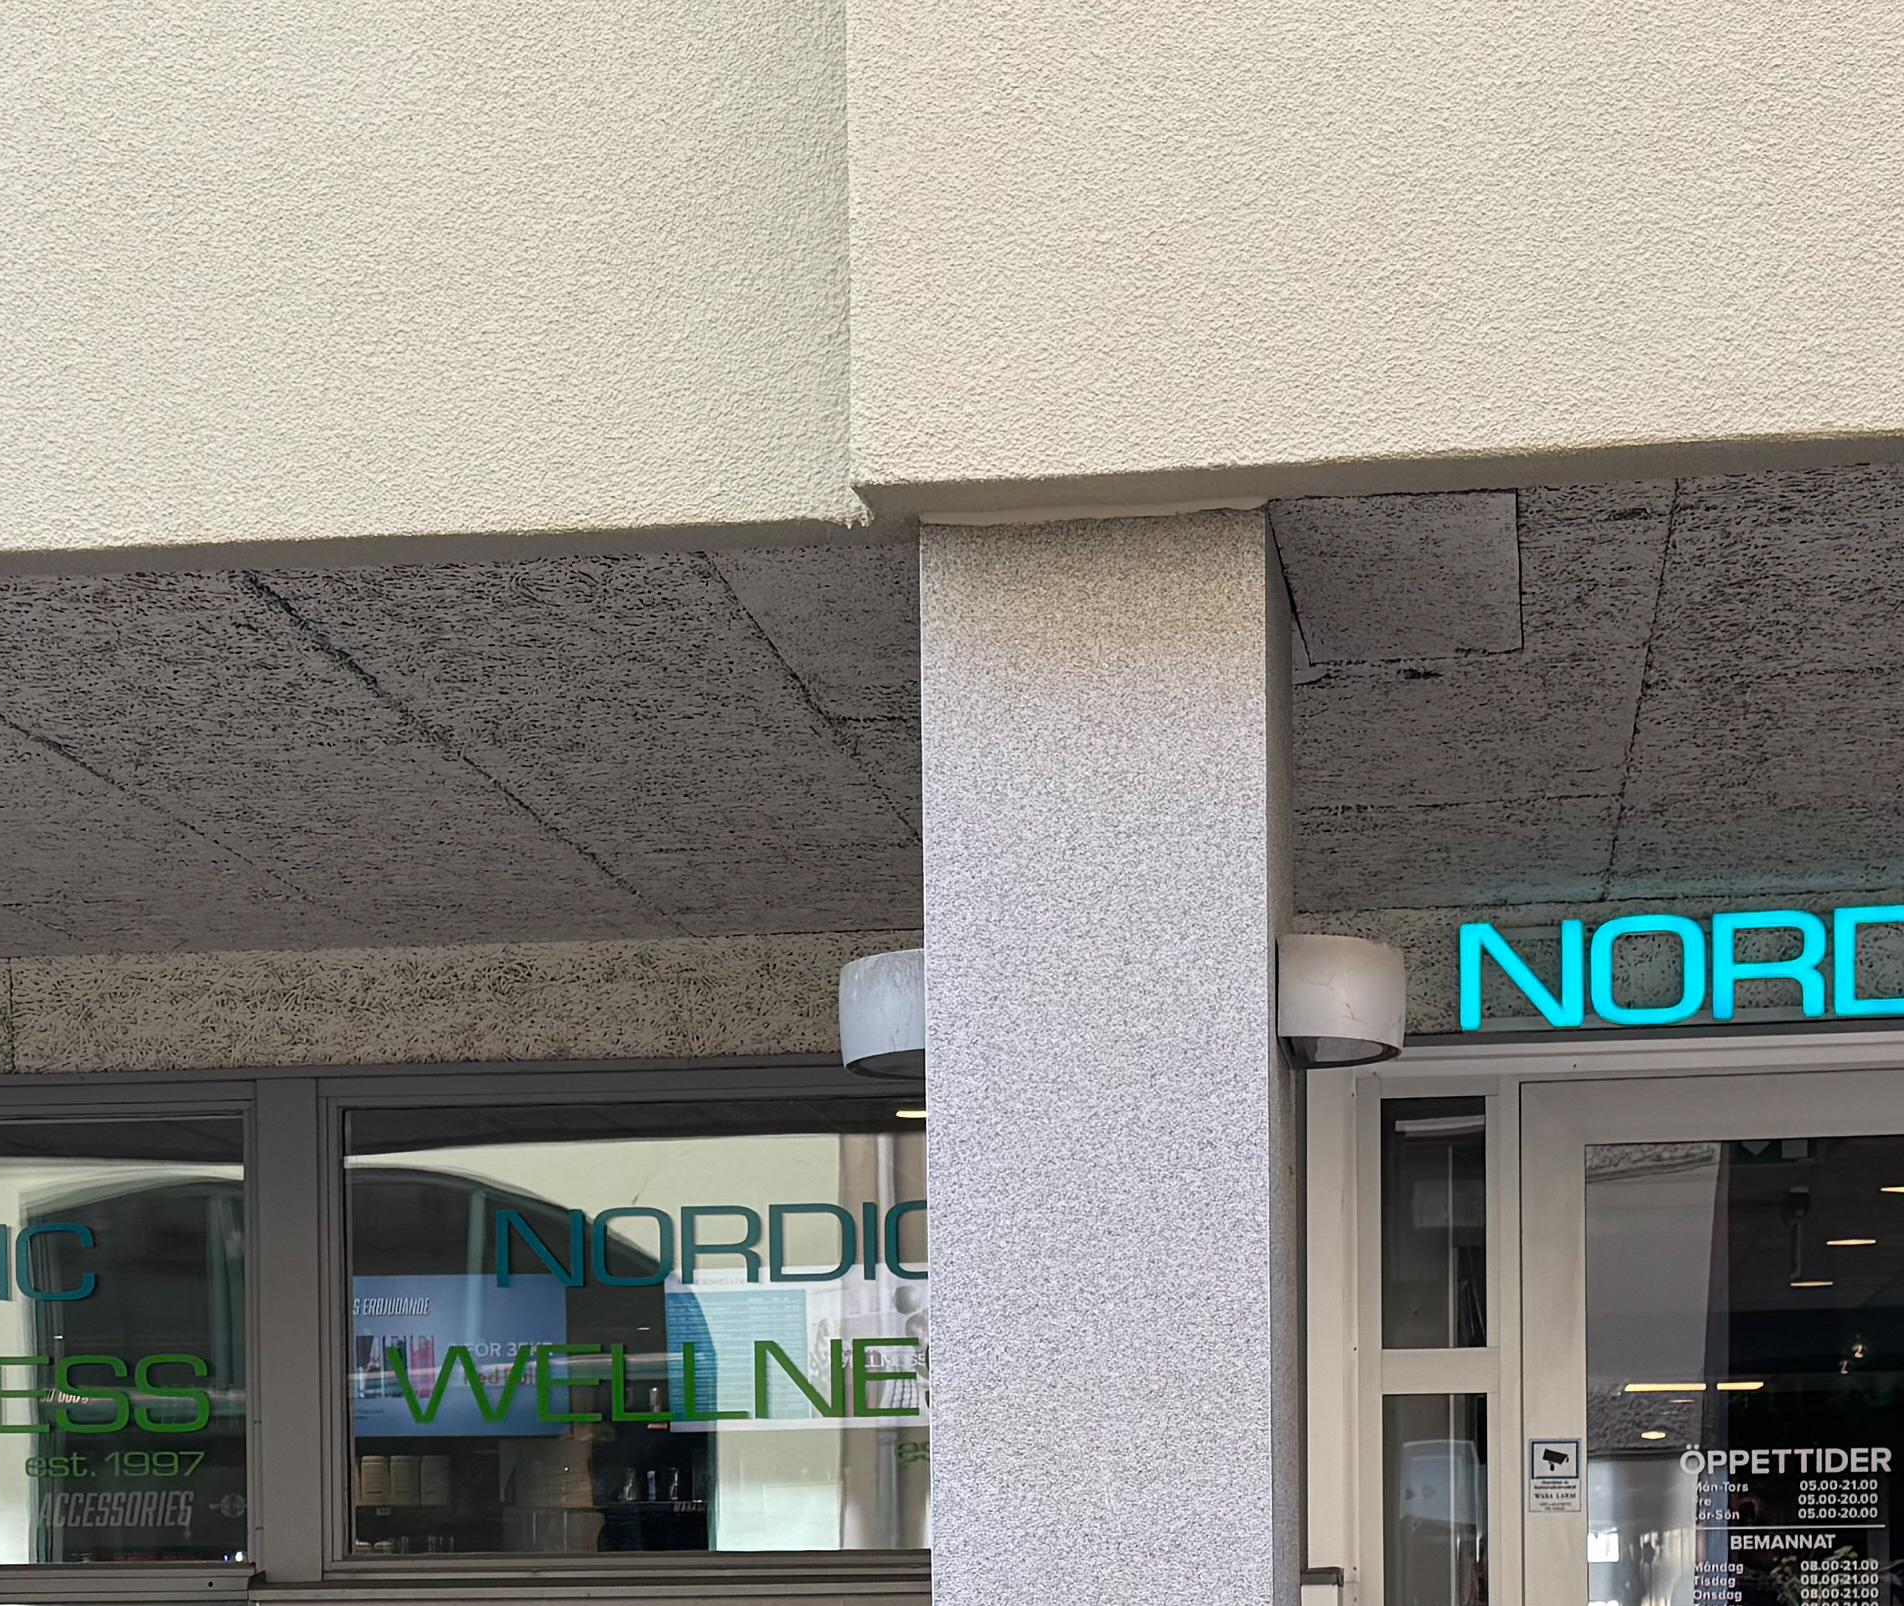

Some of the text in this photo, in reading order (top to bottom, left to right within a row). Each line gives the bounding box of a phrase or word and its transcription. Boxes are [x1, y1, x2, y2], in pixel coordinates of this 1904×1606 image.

[386, 1337, 929, 1424] WELLNE
[24, 1451, 206, 1478] est. 1997
[1679, 1444, 1892, 1475] ÖPPETTIDER
[39, 1490, 195, 1528] ACCESSORIES
[1730, 1533, 1837, 1550] BEMANNAT
[1692, 1575, 1736, 1588] Tisdag
[1692, 1589, 1742, 1602] Onsdag
